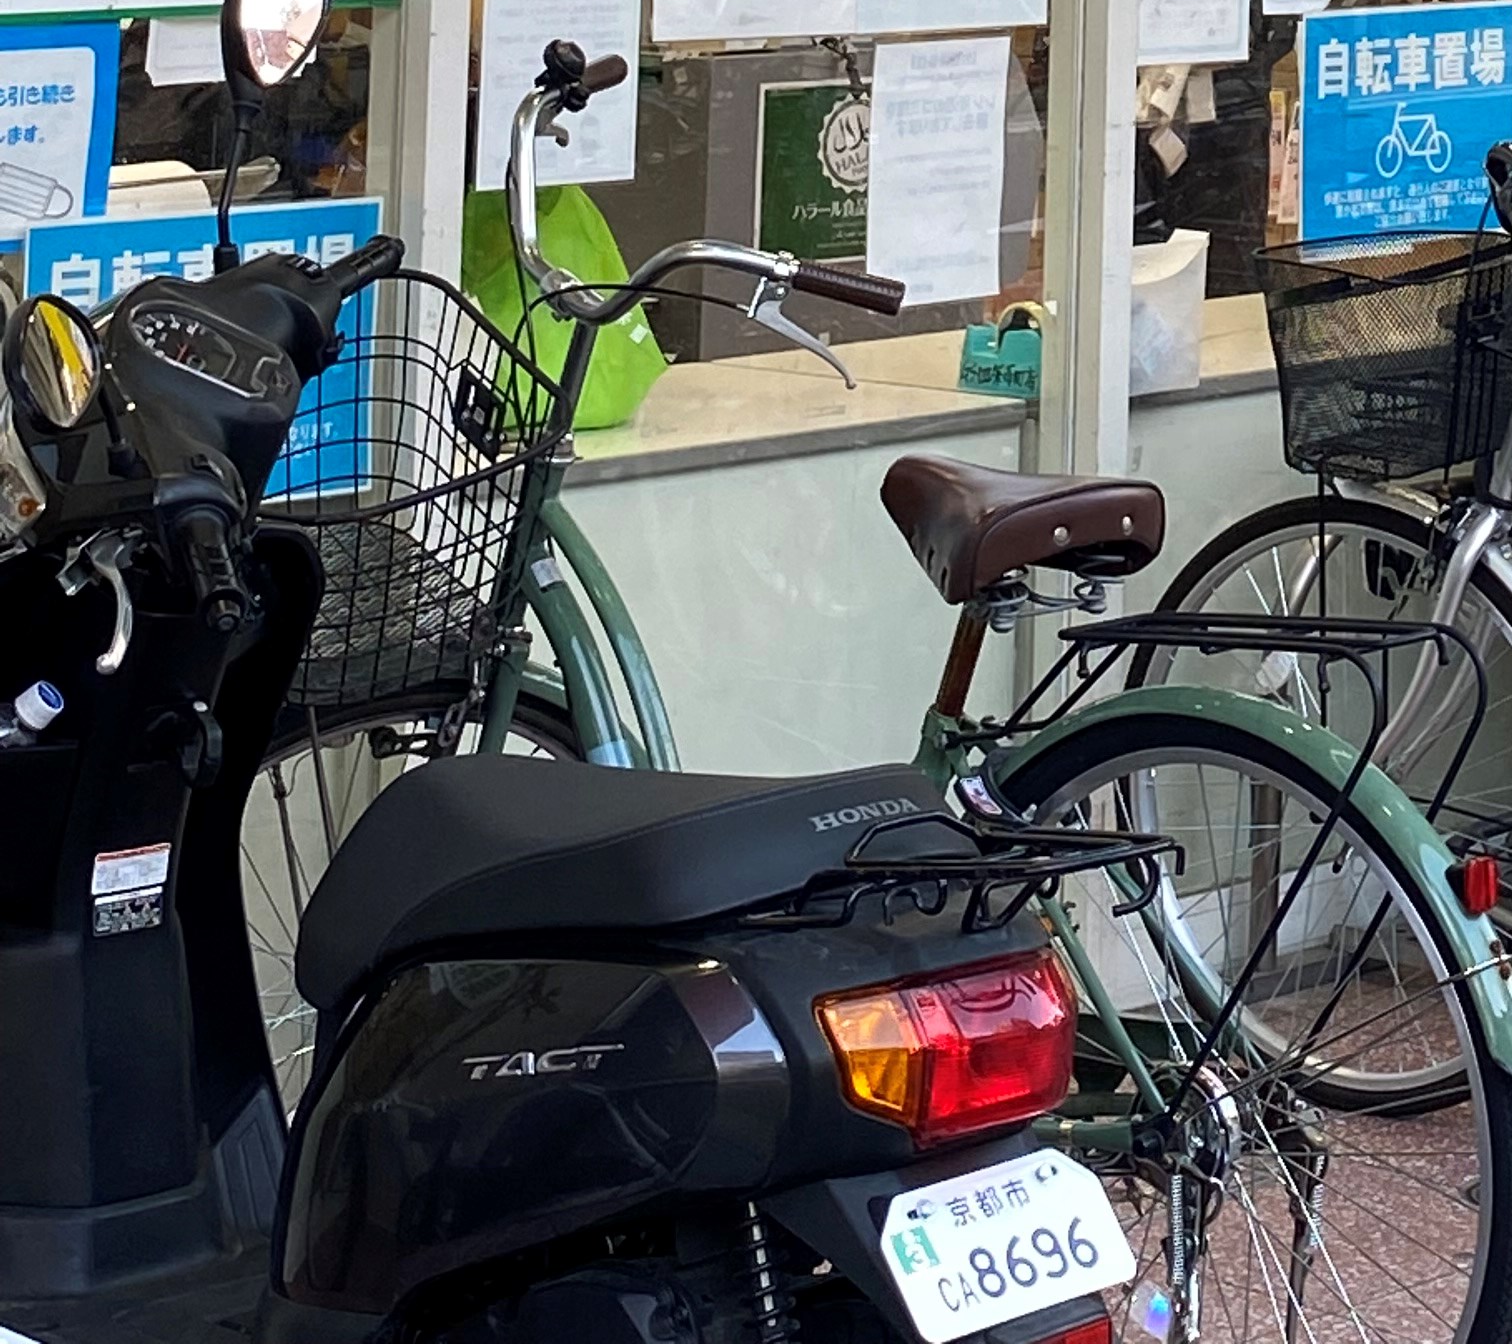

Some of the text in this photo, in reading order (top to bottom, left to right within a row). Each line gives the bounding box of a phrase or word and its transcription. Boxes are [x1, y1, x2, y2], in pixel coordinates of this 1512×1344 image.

[1316, 27, 1507, 100] 自転車置場
[810, 796, 921, 833] HONDA
[461, 1042, 625, 1082] TACT
[945, 1178, 1031, 1229] 京都市
[937, 1216, 1099, 1314] CA 8696
